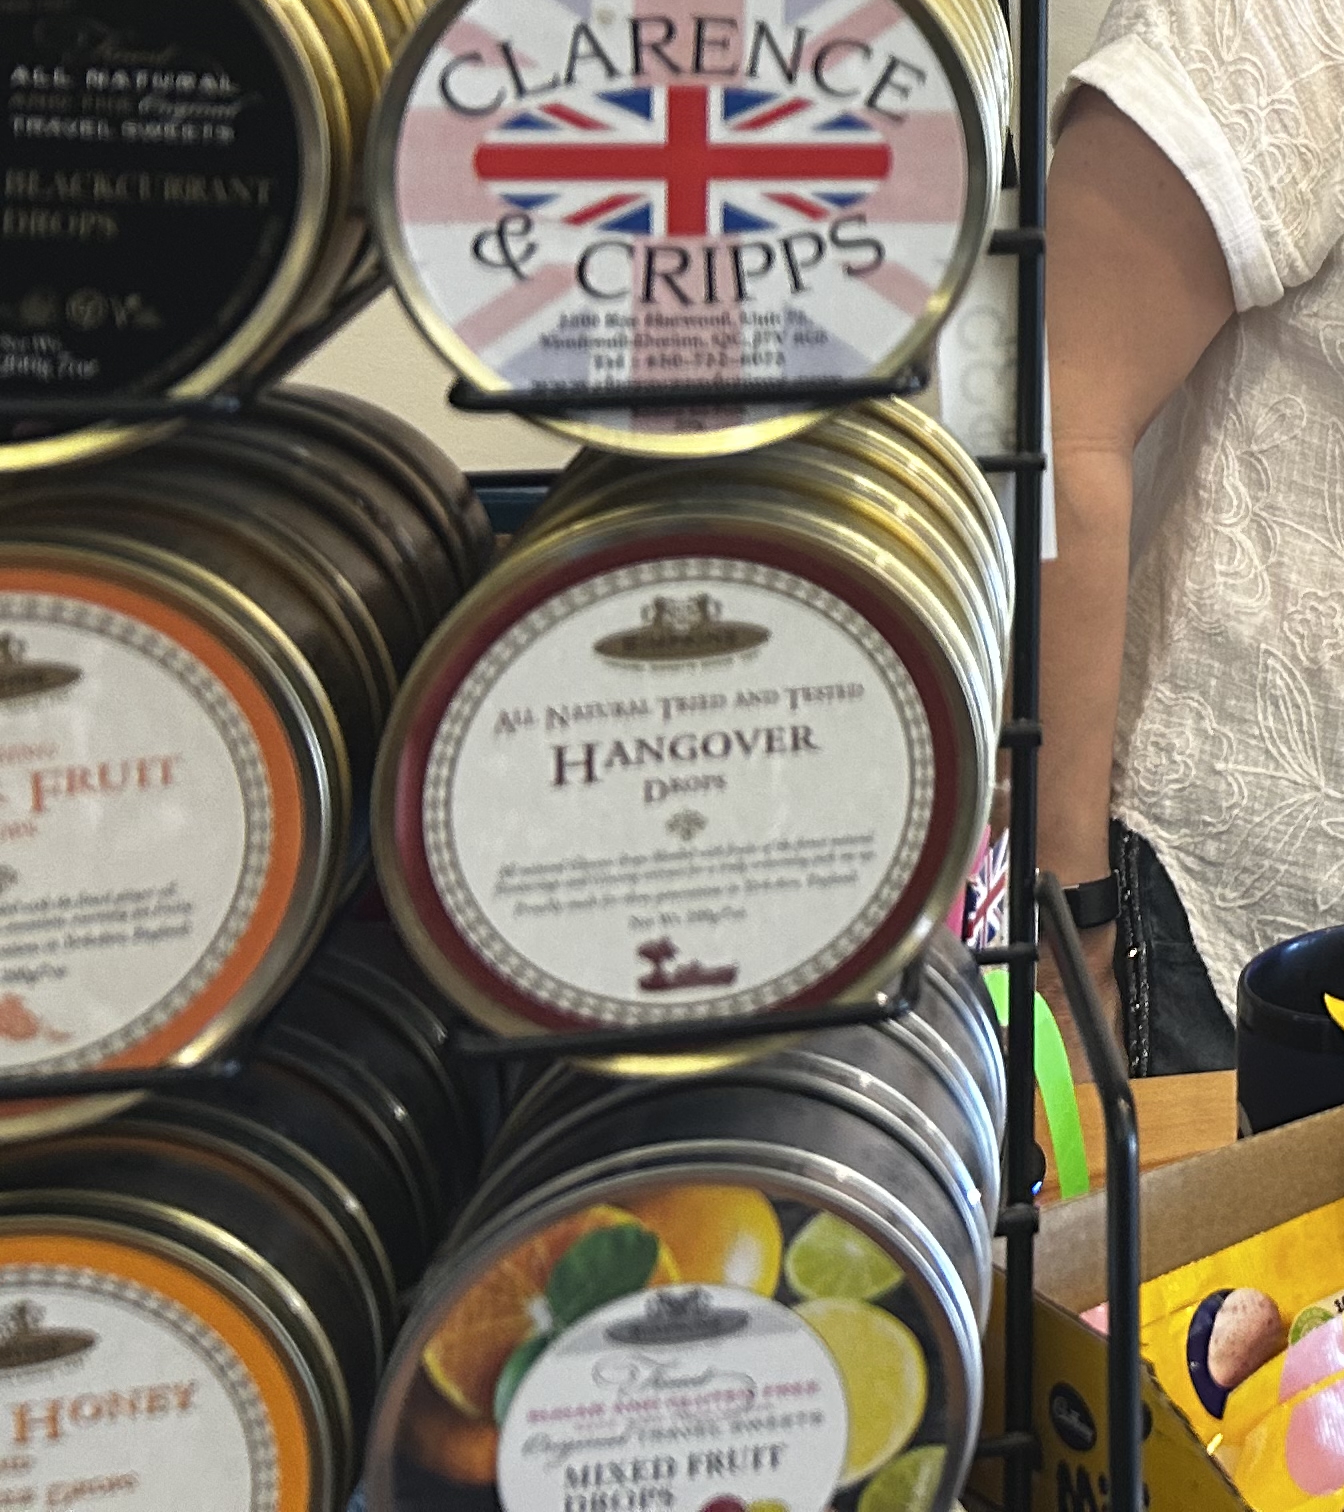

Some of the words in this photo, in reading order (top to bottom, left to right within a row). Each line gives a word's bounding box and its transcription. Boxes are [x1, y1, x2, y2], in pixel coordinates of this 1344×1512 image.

[438, 12, 927, 124] CLARENCE
[471, 212, 539, 282] &
[575, 214, 886, 305] CRIPPS
[30, 753, 184, 815] FRUIT
[550, 723, 821, 787] HANGOVER
[11, 1379, 199, 1445] HONEY
[564, 1455, 676, 1489] MIXED
[686, 1441, 787, 1481] FRUIT
